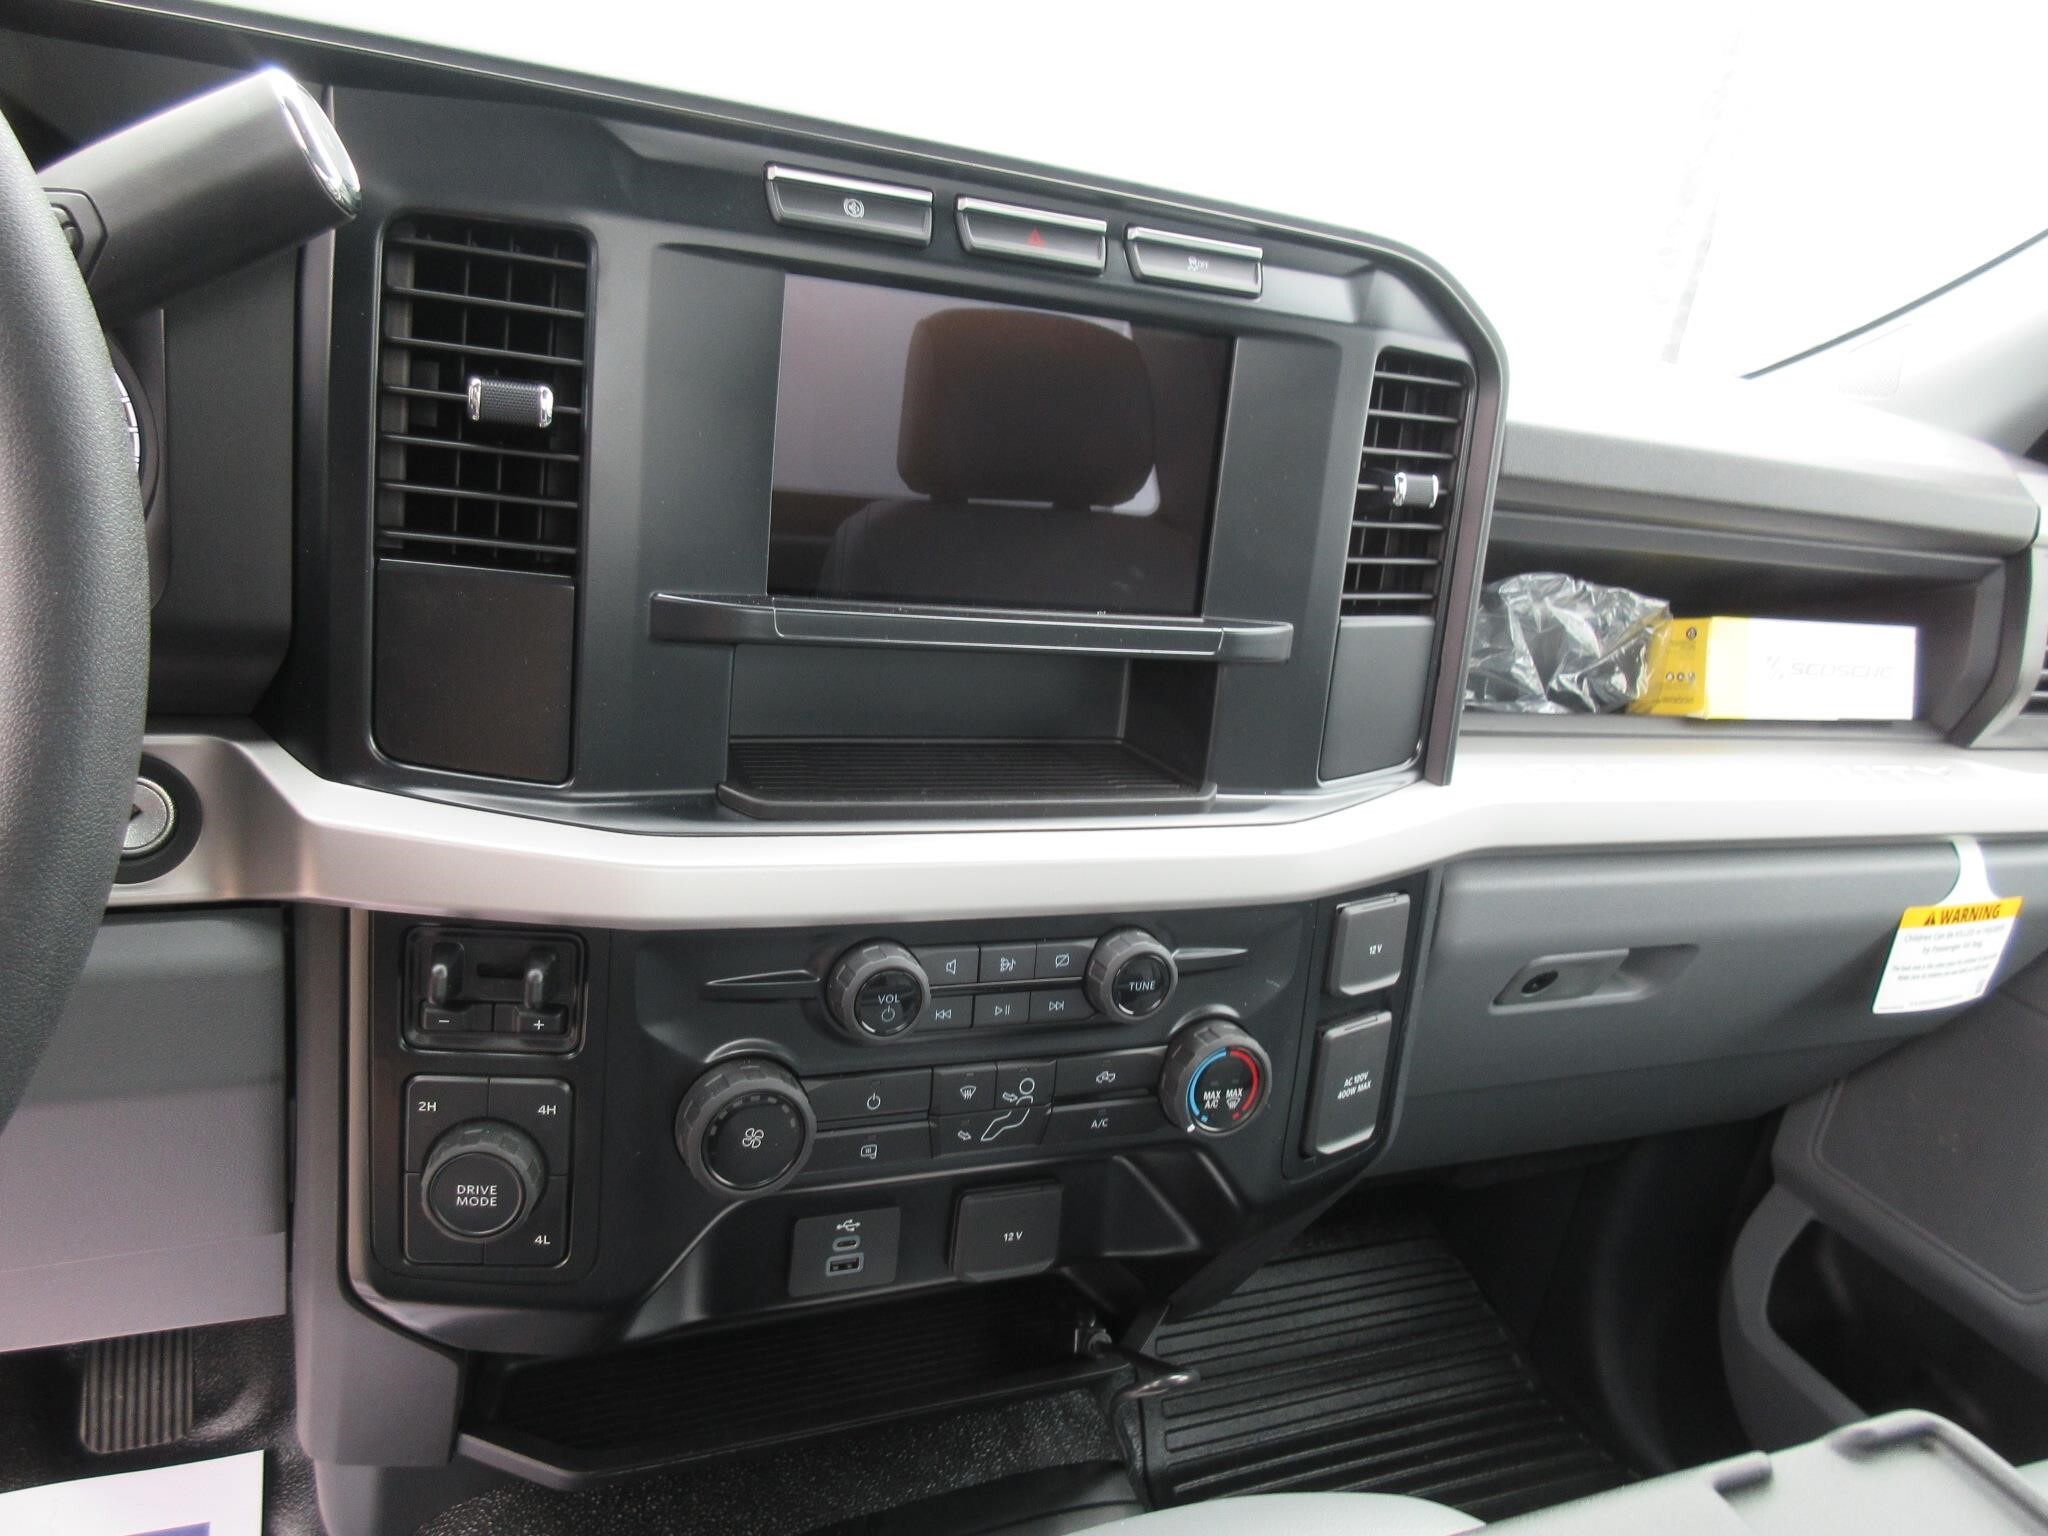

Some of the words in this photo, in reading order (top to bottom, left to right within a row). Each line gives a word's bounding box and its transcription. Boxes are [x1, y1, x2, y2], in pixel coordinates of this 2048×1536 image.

[1940, 904, 2001, 925] WARNING
[1129, 980, 1156, 991] TUNE
[878, 993, 901, 1004] VOL
[1203, 1090, 1221, 1101] MAX
[1226, 1088, 1243, 1099] MAX
[418, 1101, 437, 1112] 2H
[537, 1104, 557, 1115] 4H
[1204, 1099, 1219, 1109] A/C
[1090, 1118, 1109, 1129] A/C
[456, 1184, 498, 1195] DRIVE
[456, 1196, 498, 1207] MODE
[534, 1235, 550, 1245] 4L
